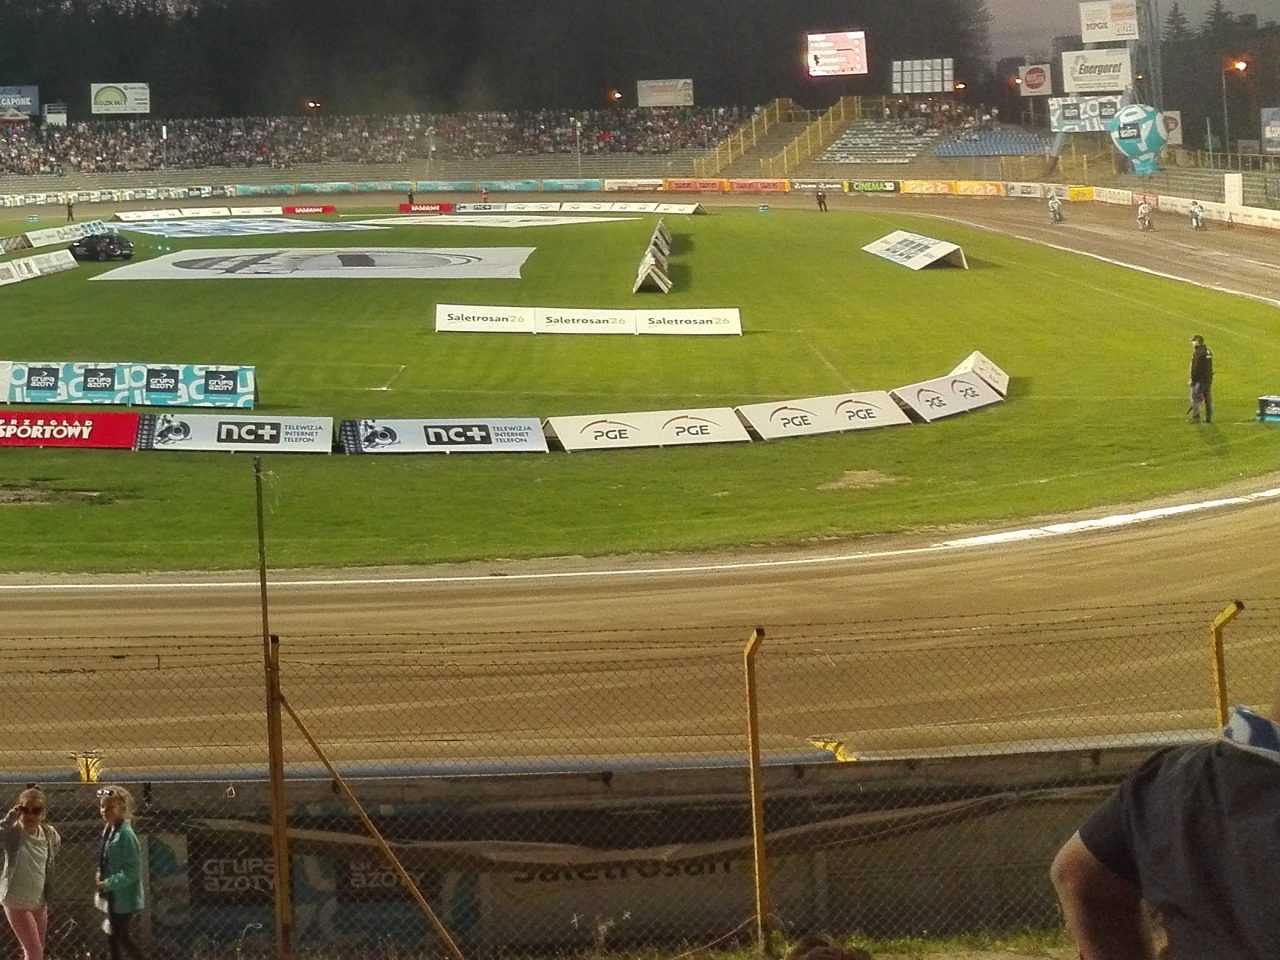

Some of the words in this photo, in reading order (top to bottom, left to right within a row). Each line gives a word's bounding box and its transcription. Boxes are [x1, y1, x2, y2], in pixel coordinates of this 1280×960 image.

[447, 313, 509, 323] Saletrosan
[546, 316, 609, 324] Saletrosan
[648, 317, 713, 325] Saletrosan
[925, 395, 948, 409] PGE
[845, 408, 877, 421] PGE
[780, 415, 812, 429] PGE
[220, 424, 277, 440] nc+
[427, 426, 486, 442] nc+
[593, 429, 629, 440] PGE
[675, 424, 710, 437] PGE
